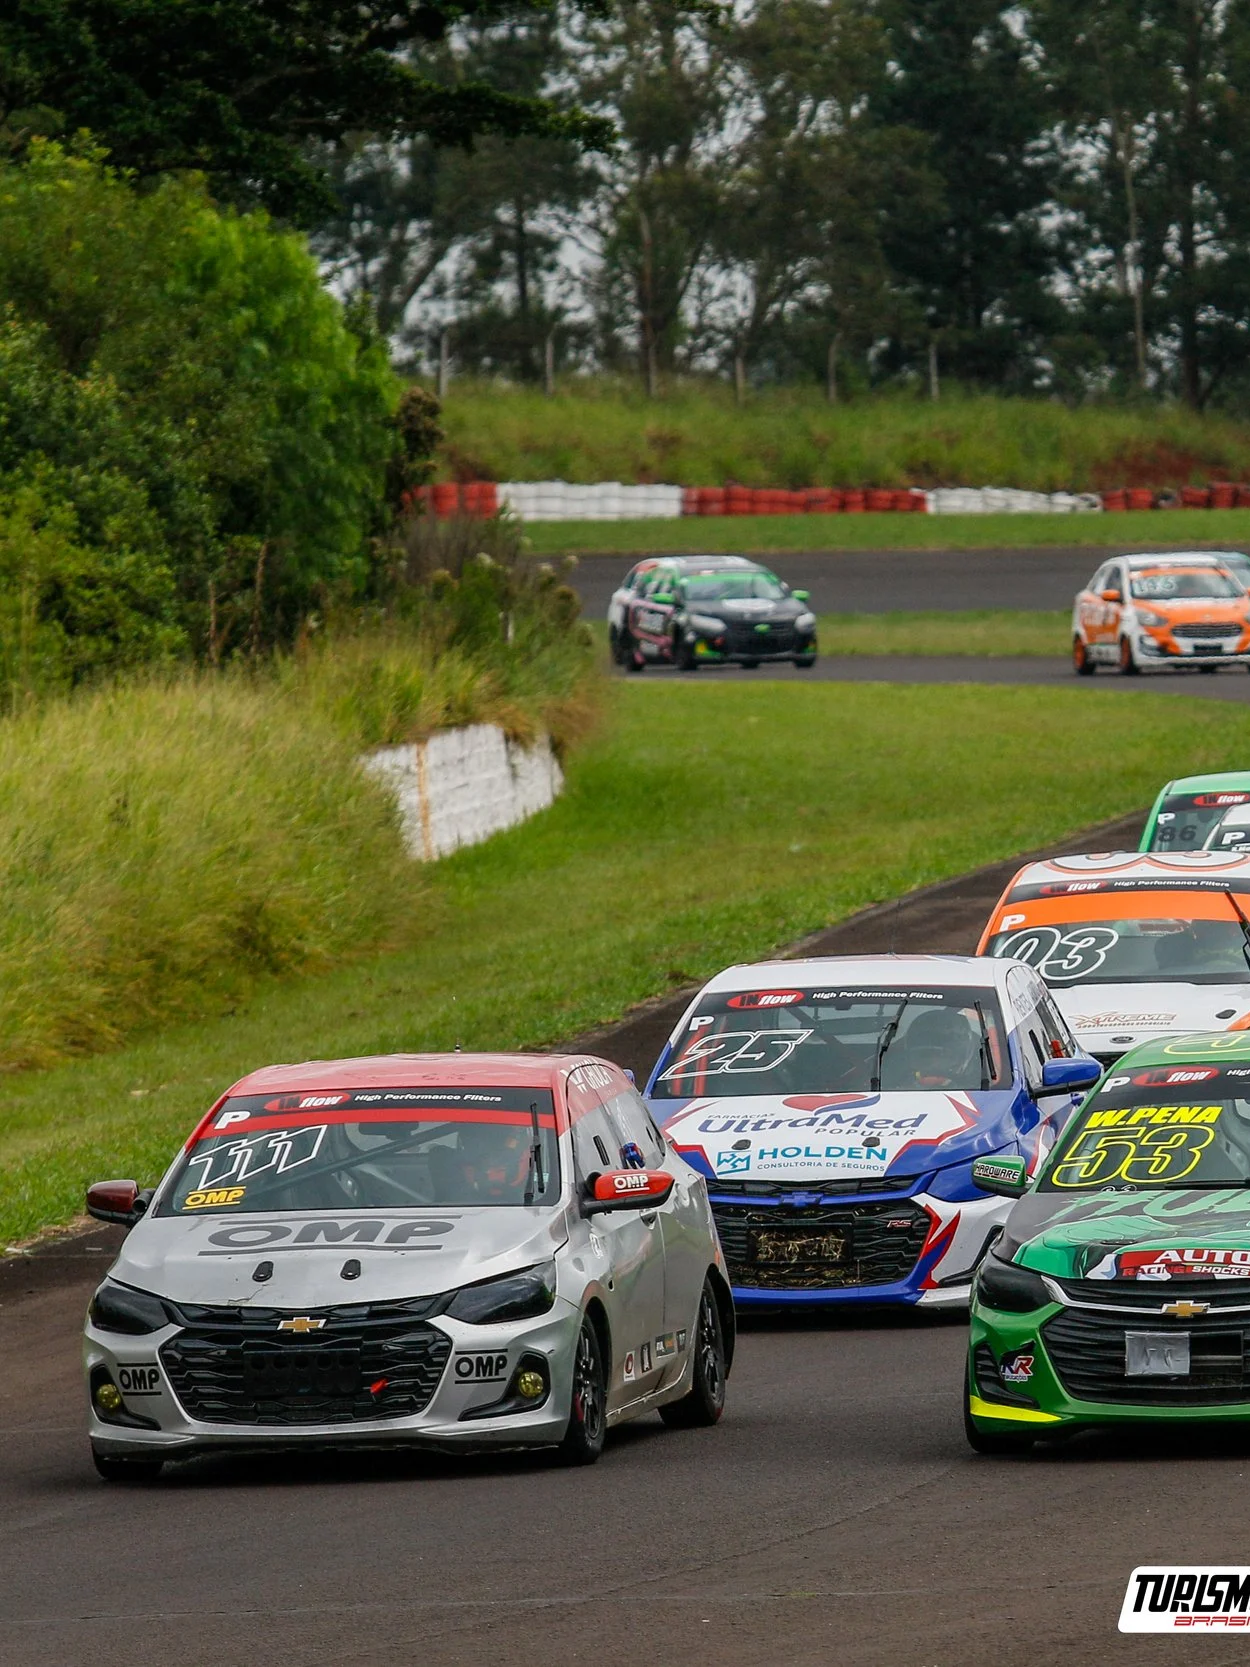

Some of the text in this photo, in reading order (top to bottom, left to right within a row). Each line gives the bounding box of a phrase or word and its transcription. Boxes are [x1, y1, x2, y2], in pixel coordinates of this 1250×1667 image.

[1157, 812, 1176, 825] P
[1158, 825, 1198, 842] 86
[1221, 831, 1246, 845] P
[1114, 880, 1136, 888] High
[1200, 880, 1230, 888] Filters
[999, 914, 1026, 932] P
[994, 926, 1119, 981] 03
[812, 991, 943, 1001] High Performance Filters
[688, 1016, 715, 1032] P
[1100, 1076, 1131, 1093] P
[354, 1092, 502, 1103] High Performance Filters
[214, 1110, 251, 1130] P
[697, 1112, 928, 1134] UltraMed
[1084, 1106, 1223, 1129] W.PENA
[815, 1128, 917, 1138] POPULAR
[188, 1124, 329, 1191] 111
[757, 1146, 888, 1162] HOLDEN
[1051, 1125, 1216, 1188] 53
[756, 1162, 824, 1171] CONSULTORIA
[841, 1163, 885, 1172] SEGUROS
[976, 1164, 1020, 1180] HARDWARE
[614, 1175, 649, 1190] OMP
[185, 1188, 245, 1206] OMP
[207, 1220, 455, 1248] OMP
[1192, 1265, 1250, 1277] SHOCKS
[454, 1355, 508, 1379] OMP
[119, 1367, 160, 1391] OMP
